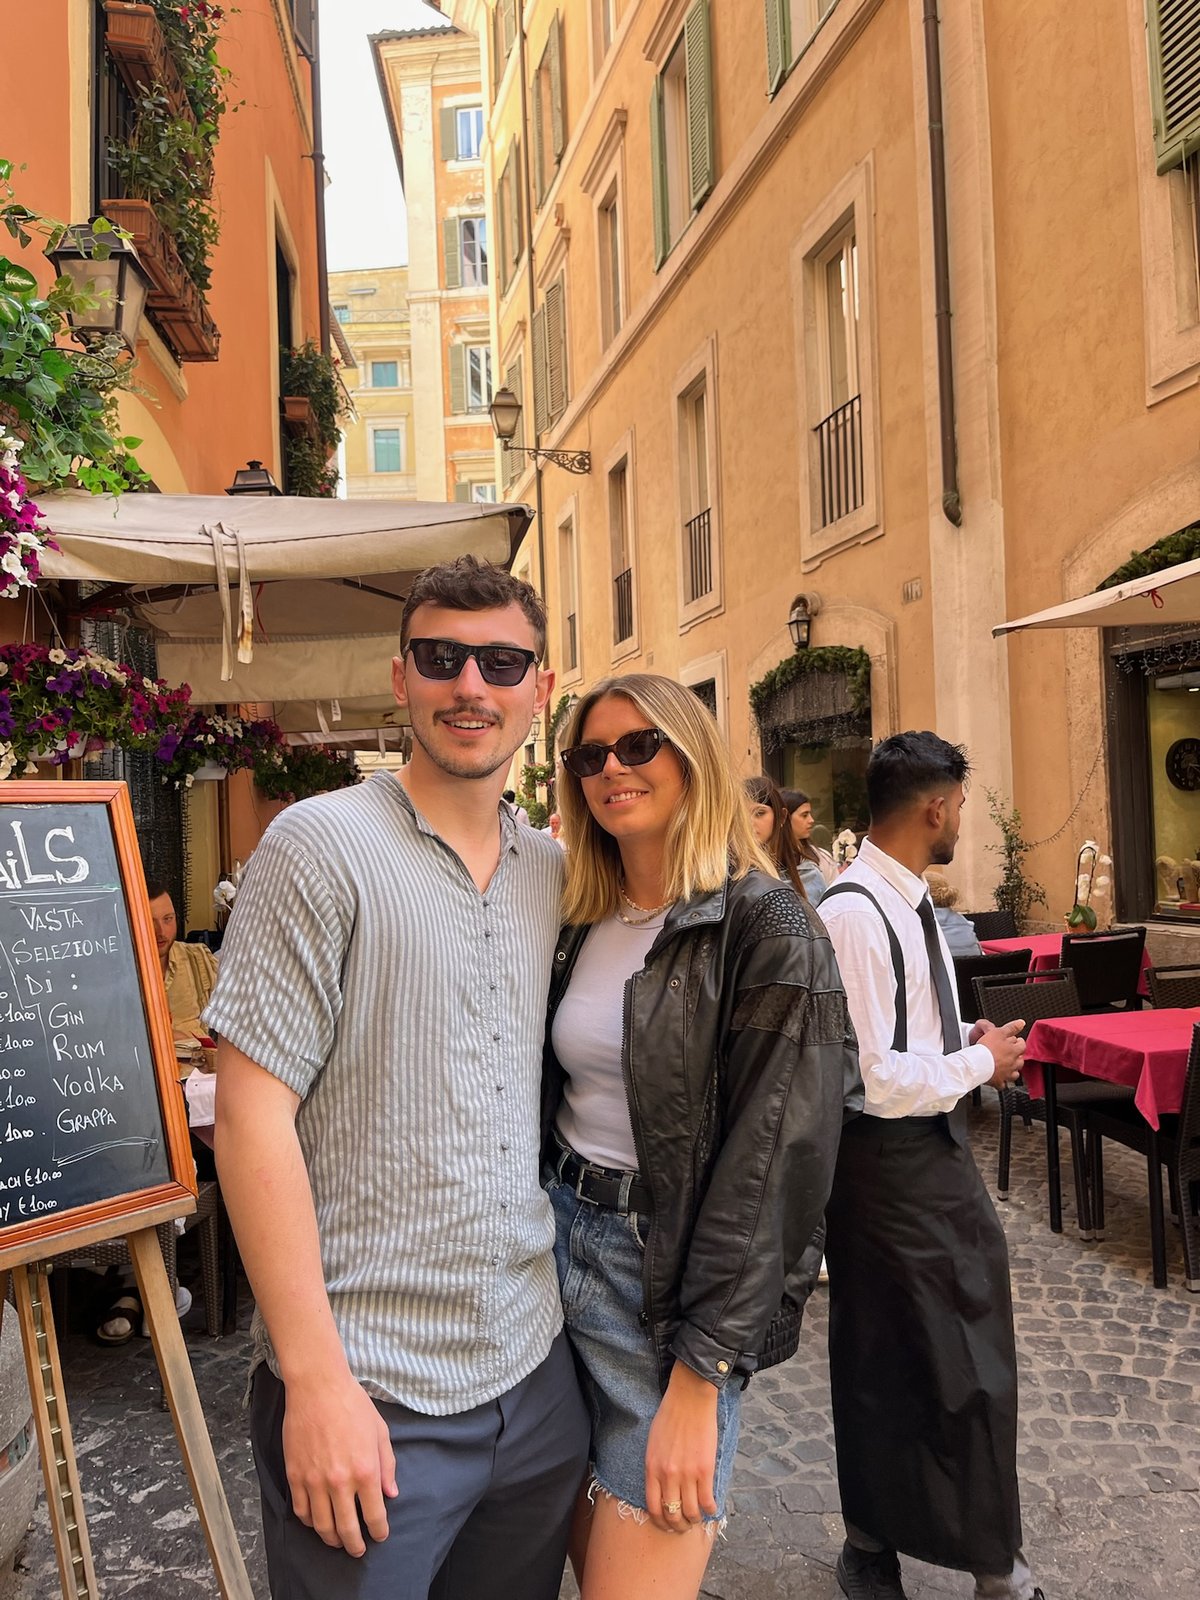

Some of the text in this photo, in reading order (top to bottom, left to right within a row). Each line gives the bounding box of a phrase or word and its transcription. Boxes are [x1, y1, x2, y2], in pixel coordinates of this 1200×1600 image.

[20, 906, 84, 932] VASTA
[11, 935, 119, 965] SELEZIONE
[52, 1033, 106, 1062] RUM
[56, 1107, 117, 1134] GRAPPA
[24, 1167, 63, 1188] €10,00
[18, 1194, 58, 1216] €10,00
